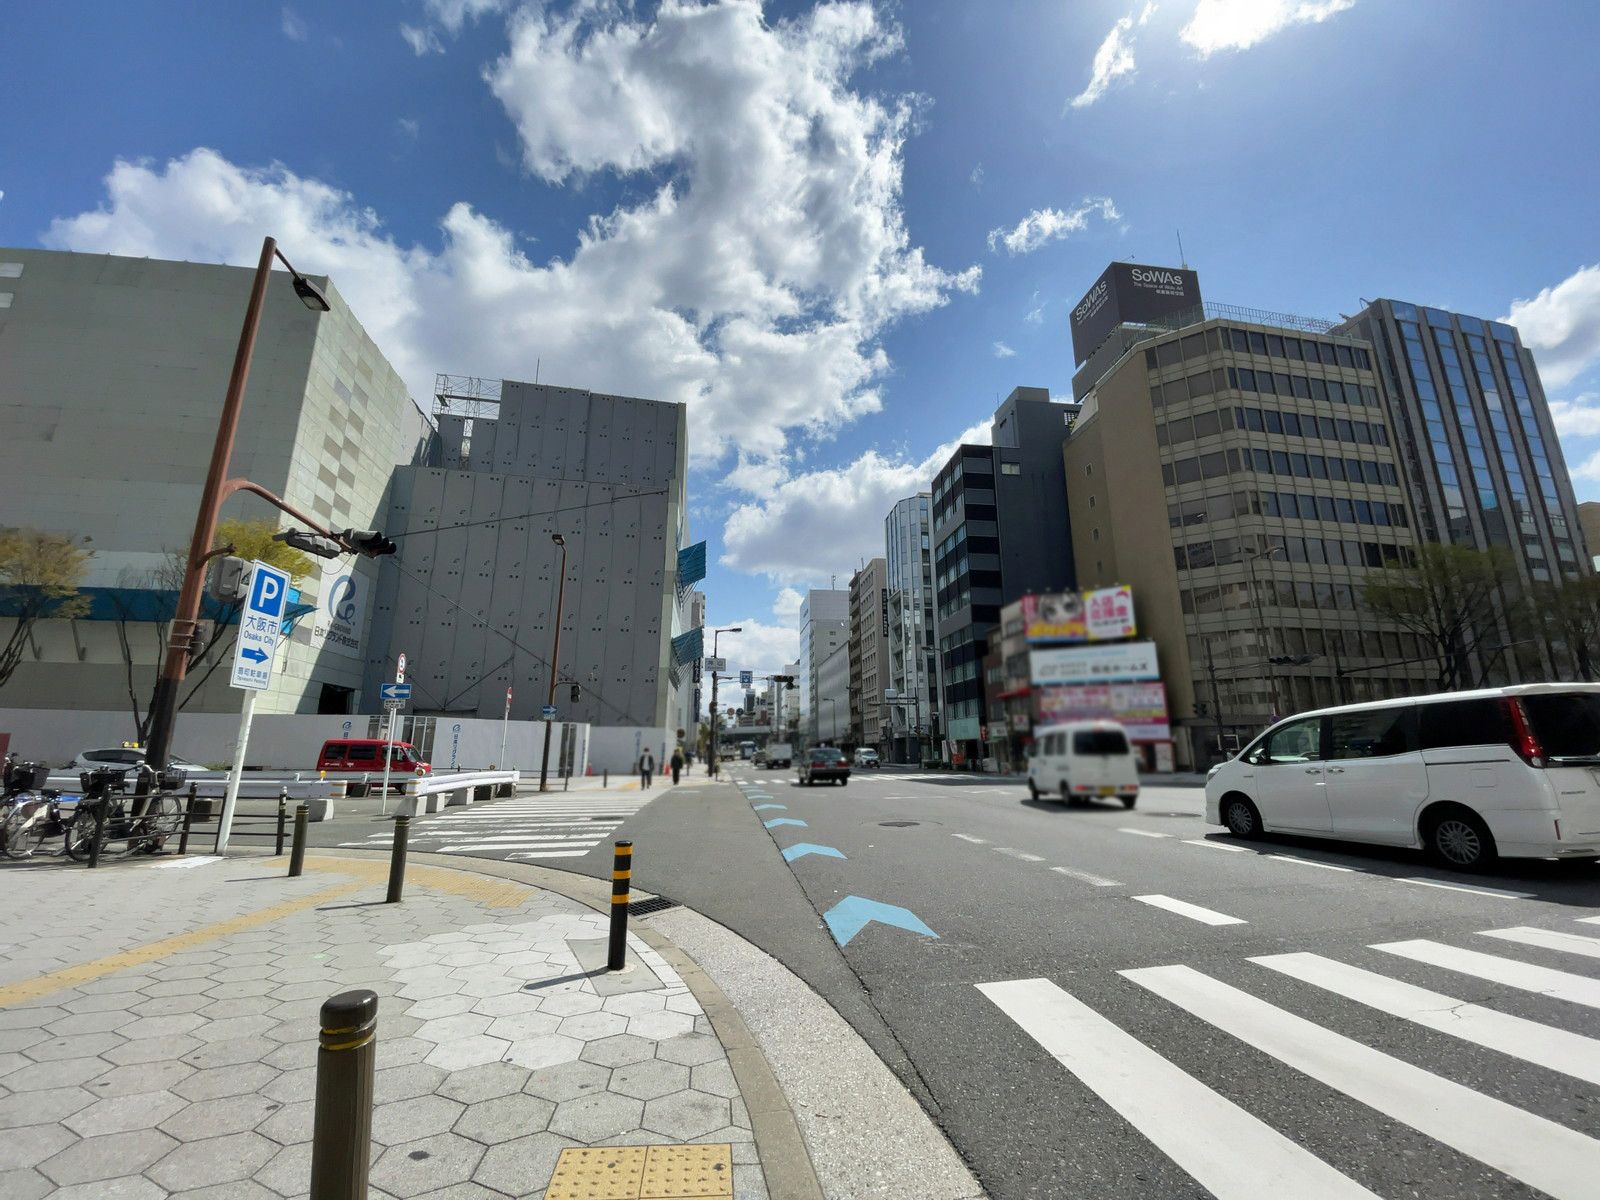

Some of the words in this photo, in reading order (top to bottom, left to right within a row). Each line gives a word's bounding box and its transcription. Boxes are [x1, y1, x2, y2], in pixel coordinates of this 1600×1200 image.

[1131, 268, 1183, 285] SoWAs
[1076, 280, 1107, 320] SoWAs
[258, 576, 278, 608] P
[246, 615, 278, 634] 大阪市
[244, 630, 262, 642] Osaka
[264, 636, 274, 646] City
